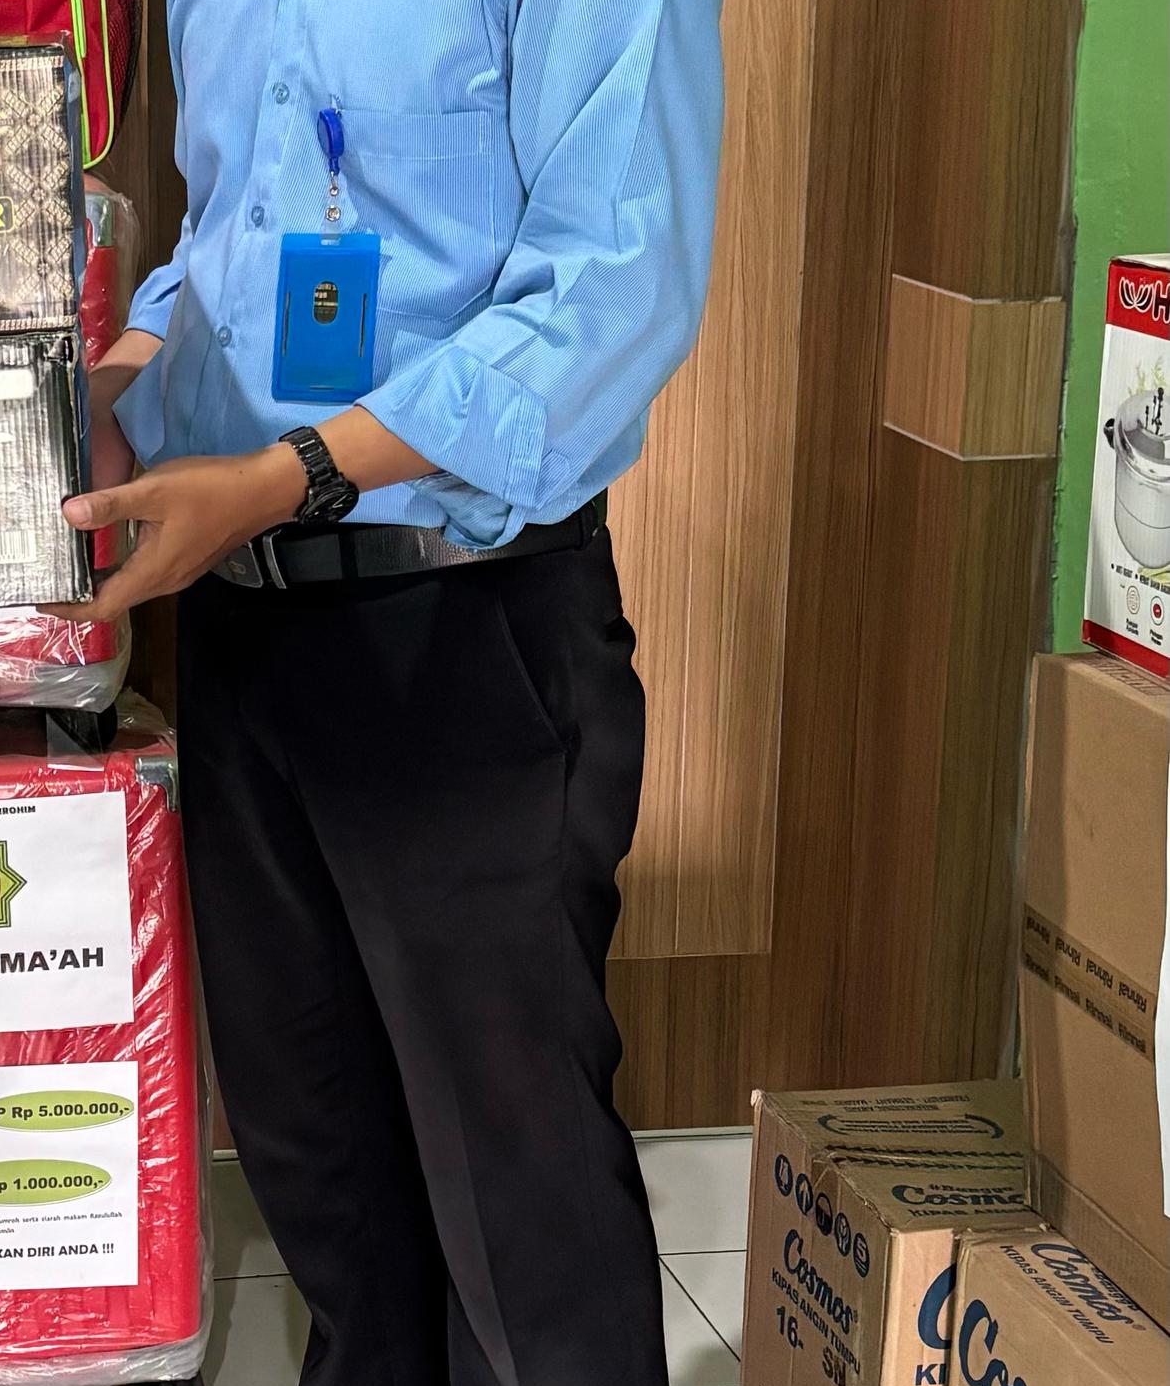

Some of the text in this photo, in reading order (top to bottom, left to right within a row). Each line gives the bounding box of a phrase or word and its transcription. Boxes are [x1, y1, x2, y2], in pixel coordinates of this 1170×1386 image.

[12, 1107, 33, 1123] Rp
[38, 1102, 130, 1118] 5.000.000,-
[13, 1175, 104, 1190] 1.000.000,-
[27, 1246, 55, 1257] DIRI
[59, 1244, 99, 1256] ANDA
[103, 1243, 114, 1254] !!!
[783, 1228, 852, 1335] Cosmos
[1031, 1243, 1134, 1325] Cosmos
[772, 1267, 861, 1375] KIPAS ANGIN TUMPU
[1000, 1245, 1038, 1275] KIPAS
[1031, 1276, 1073, 1307] ANGIN
[1067, 1309, 1115, 1344] TUMPU
